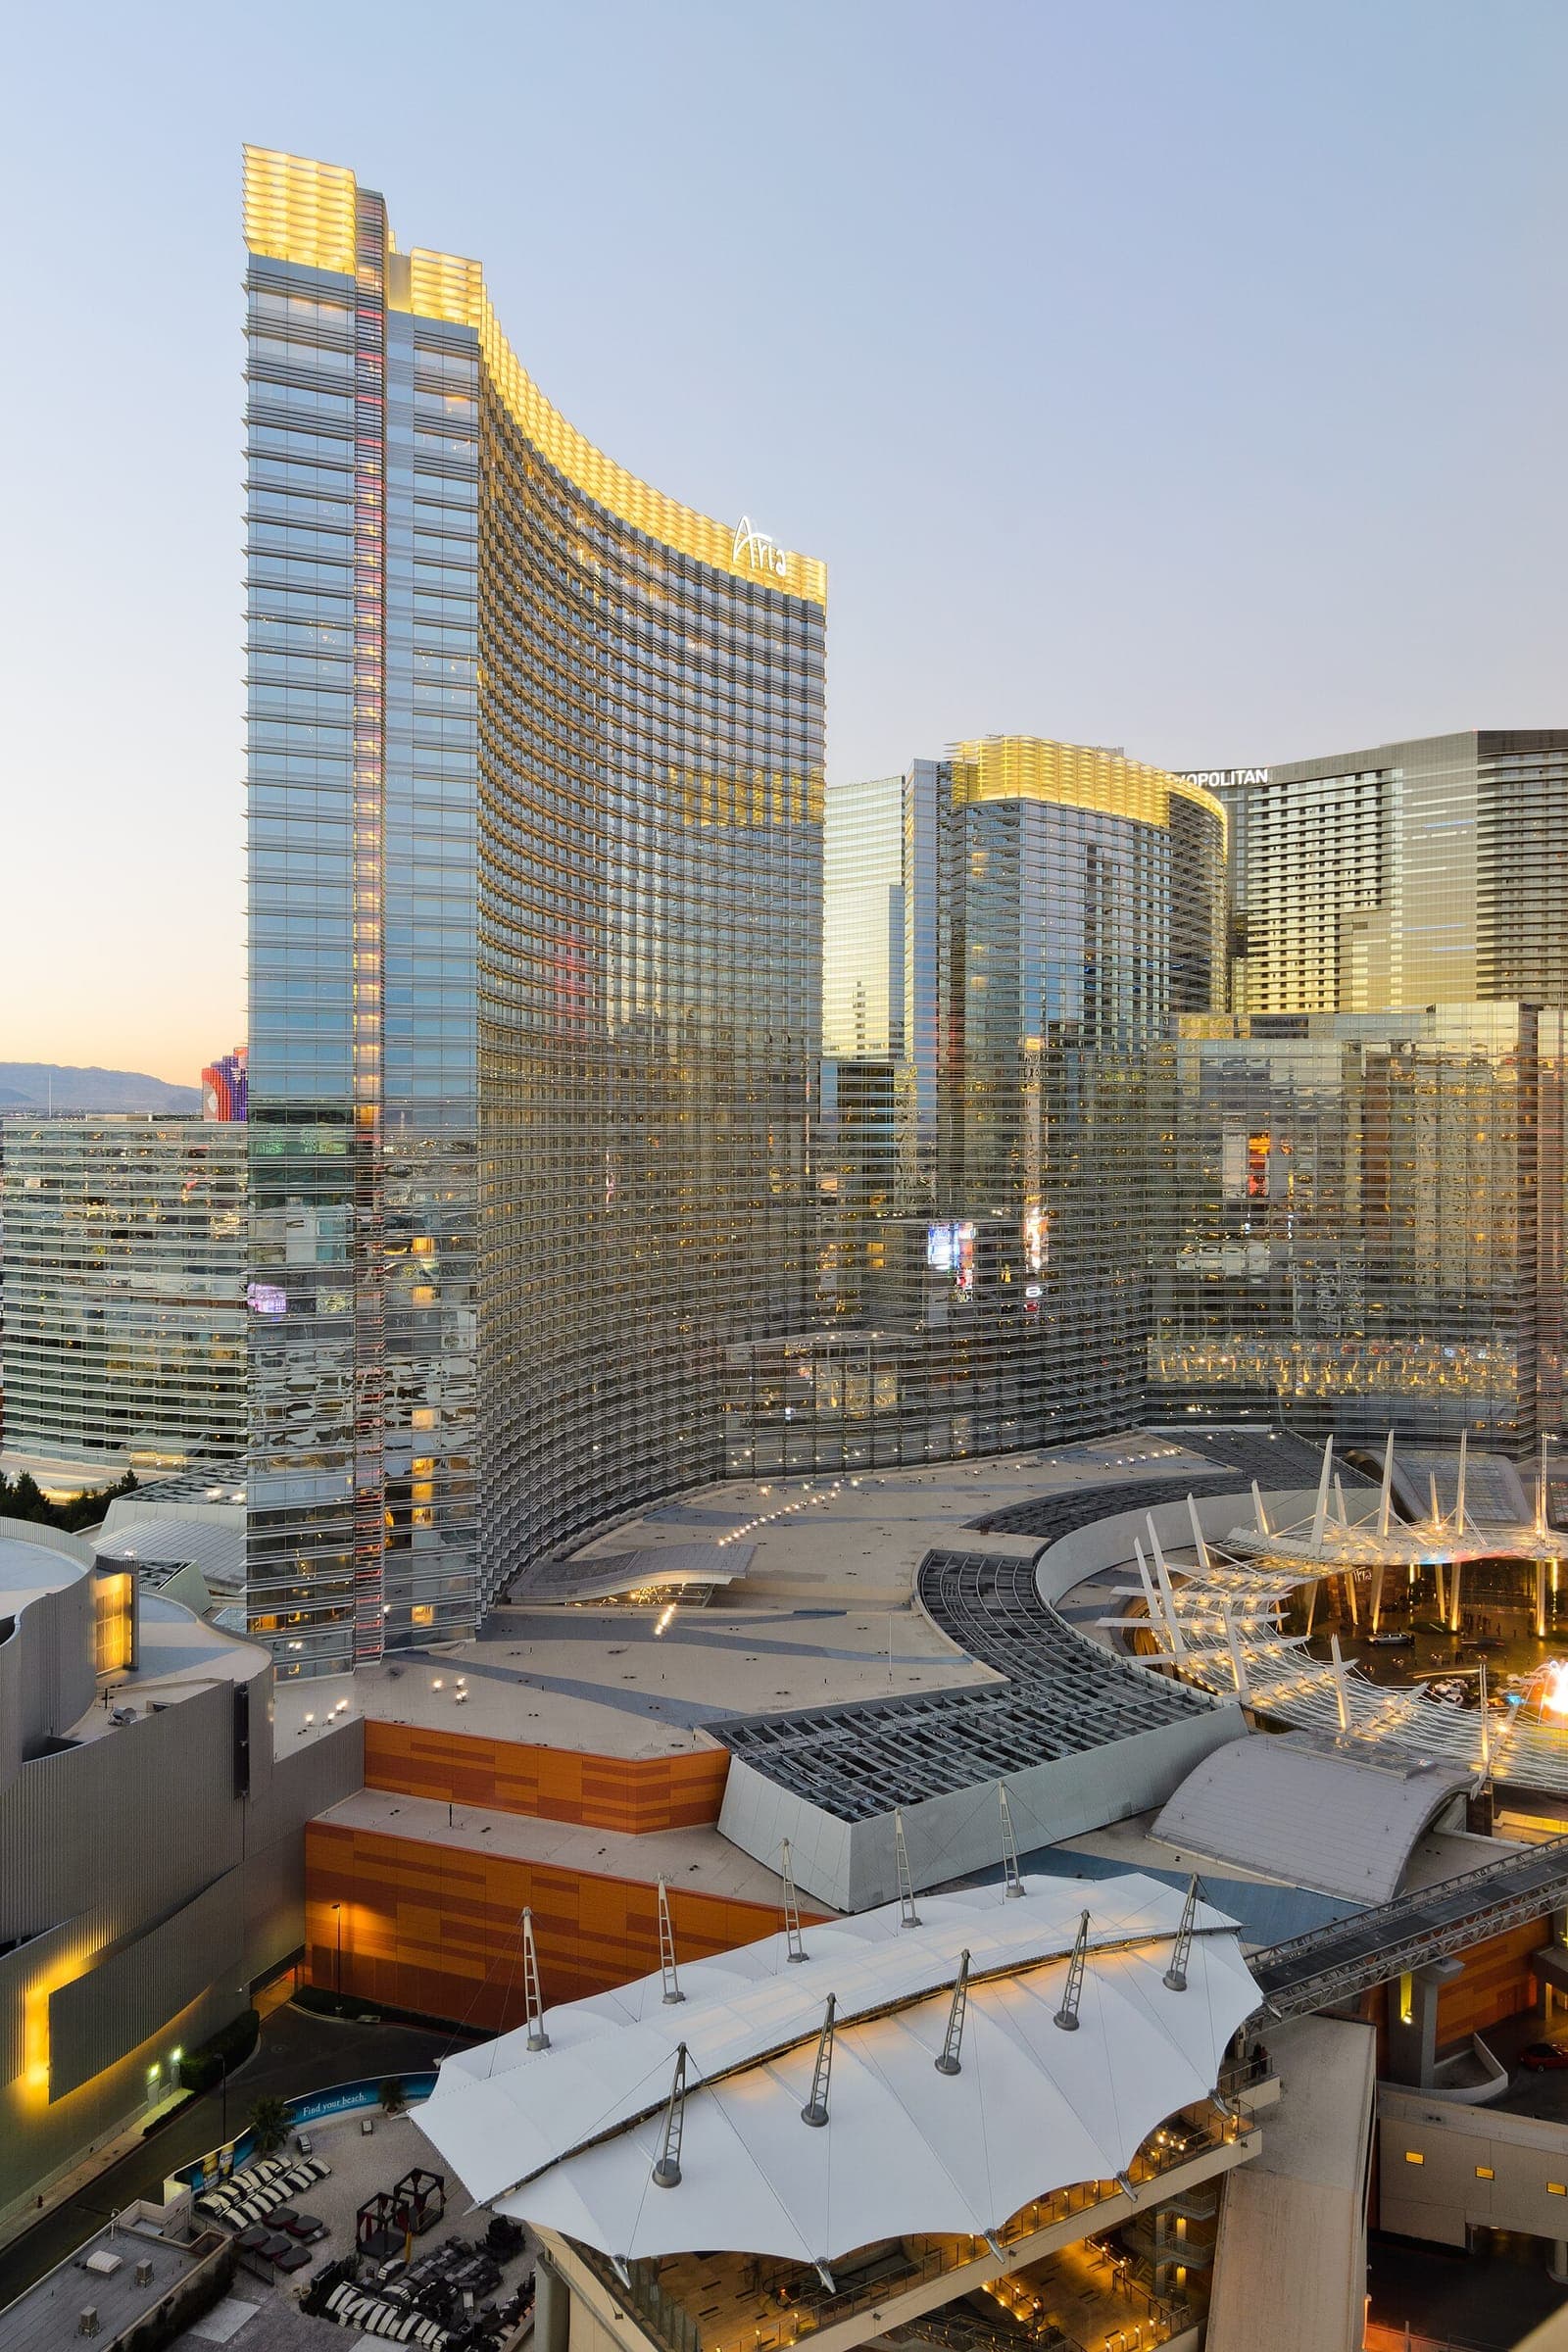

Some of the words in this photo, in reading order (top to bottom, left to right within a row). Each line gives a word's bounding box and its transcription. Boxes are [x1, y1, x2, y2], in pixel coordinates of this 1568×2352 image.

[732, 515, 787, 576] Aria
[1178, 768, 1268, 787] OPOLITAN
[303, 2103, 320, 2117] Find
[322, 2100, 340, 2113] your
[342, 2092, 368, 2107] beach.
